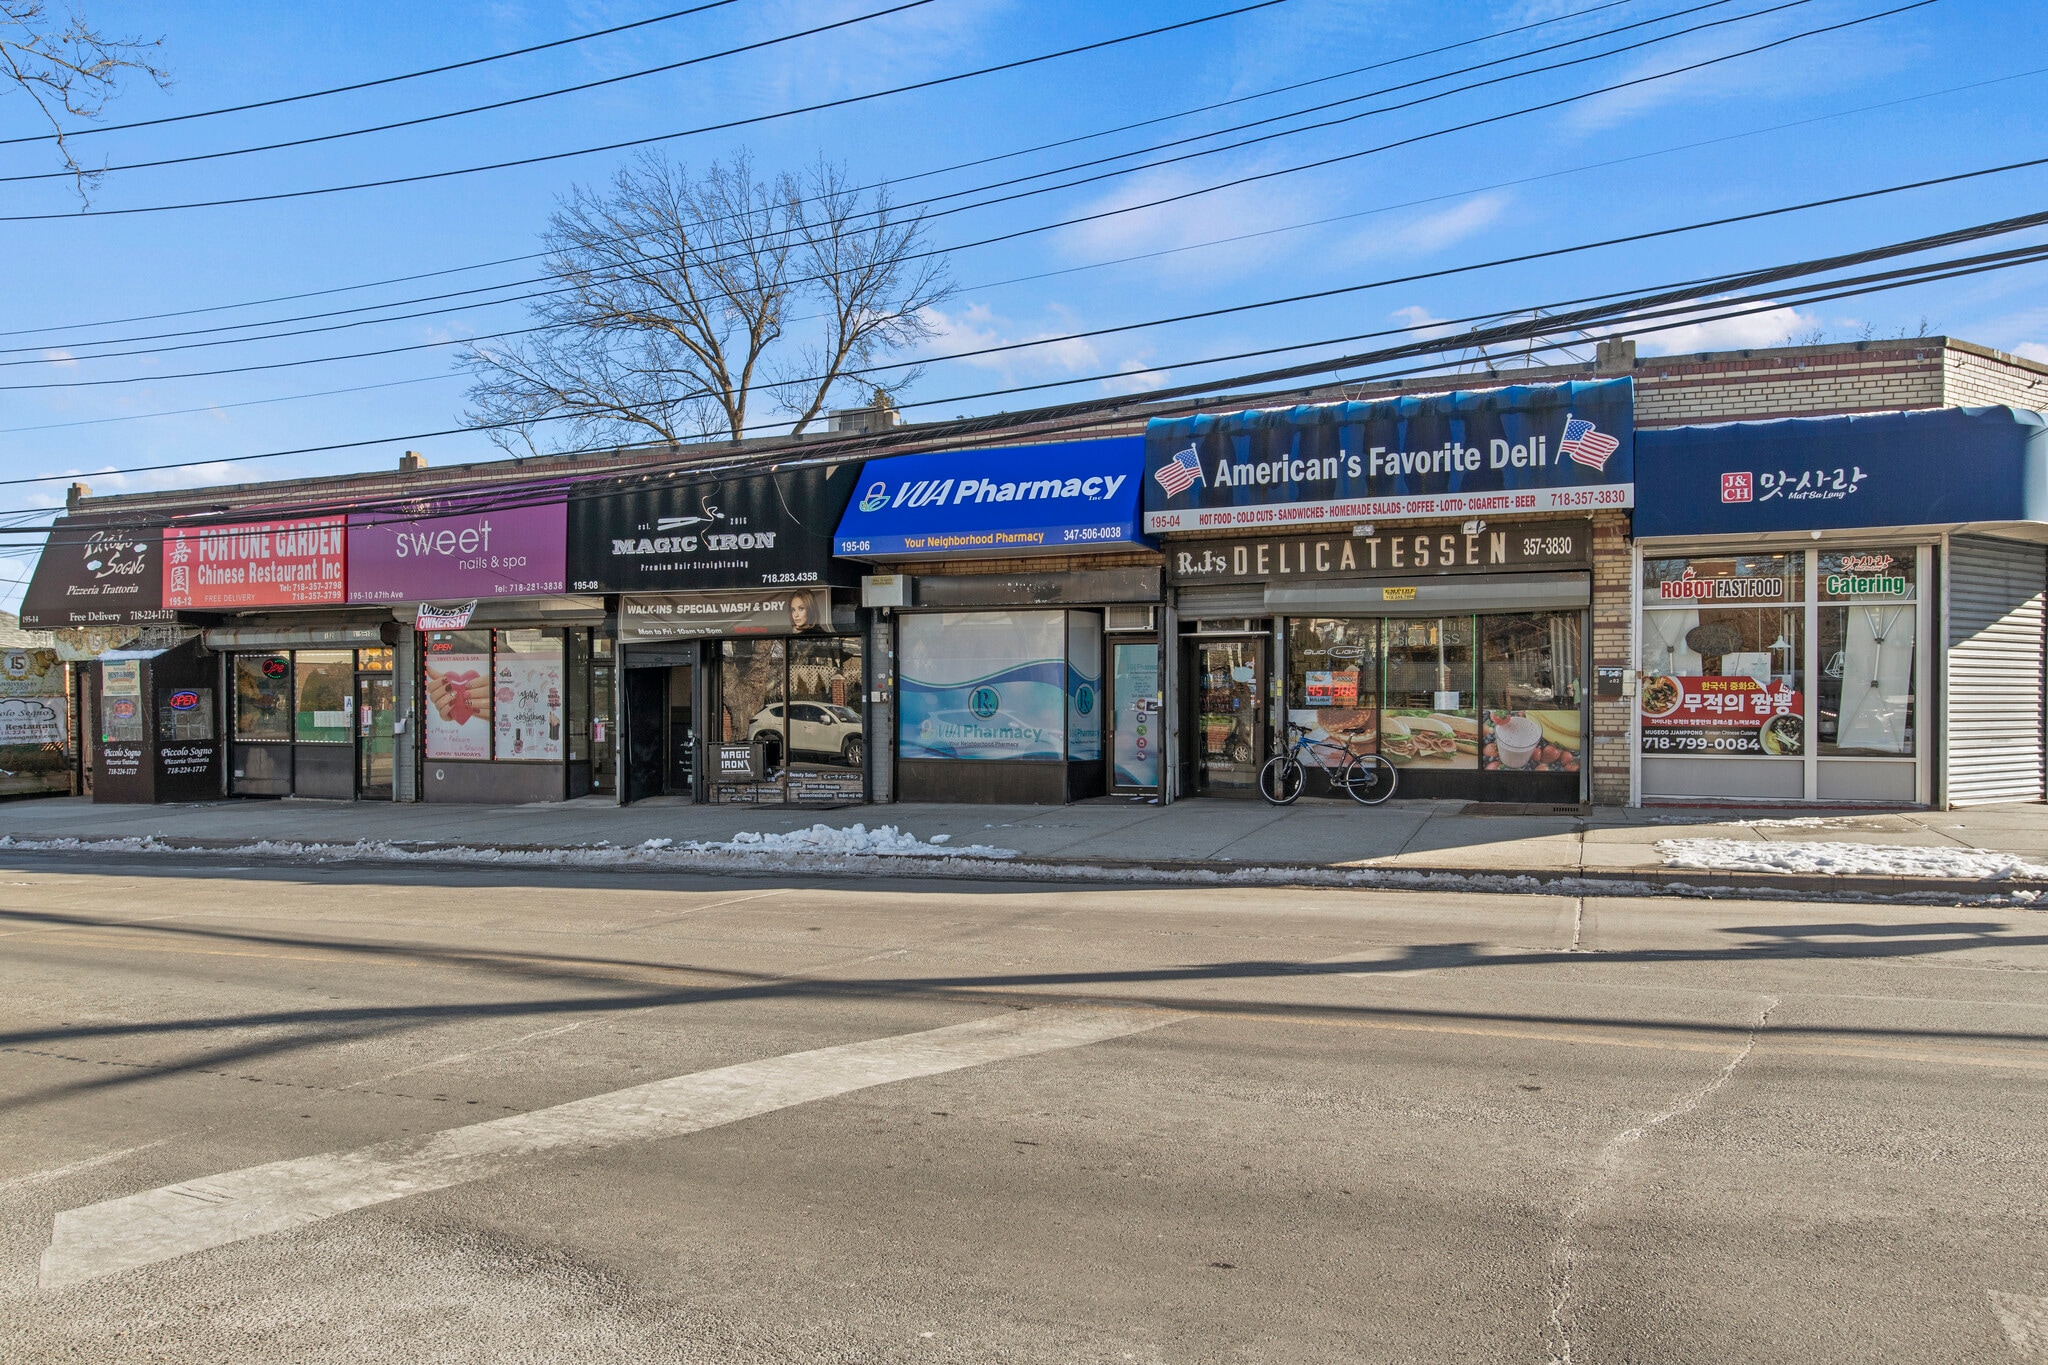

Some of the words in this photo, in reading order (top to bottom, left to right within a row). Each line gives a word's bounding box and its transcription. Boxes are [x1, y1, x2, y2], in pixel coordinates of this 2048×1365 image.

[1214, 448, 1362, 489] American's
[1369, 441, 1481, 478] Favorite
[1489, 435, 1546, 470] Deli
[1725, 474, 1747, 488] J&
[953, 474, 1127, 505] Pharmacy
[1723, 488, 1750, 501] CH
[1551, 489, 1626, 507] 718-357-3830
[1199, 513, 1213, 525] HOT
[1213, 512, 1232, 524] FOOD
[1236, 511, 1255, 523] COLD
[1256, 510, 1274, 522] CUTS
[1278, 506, 1325, 520] SANDWICHES
[1329, 503, 1372, 517] HOMEMADE
[1372, 501, 1401, 515] SALADS
[1406, 499, 1435, 513] COFFEE
[1440, 498, 1463, 511] LOTTO
[1468, 496, 1510, 510] CIGARETTE
[1515, 494, 1536, 508] BEER
[1150, 515, 1181, 528] 195-04
[199, 525, 271, 562] FORTUNE
[275, 519, 342, 559] GARDEN
[396, 520, 492, 558] sweet
[904, 536, 925, 549] Your
[927, 533, 994, 548] Neighborhood
[996, 531, 1045, 545] Pharmacy
[1063, 527, 1121, 541] 347-506-0038
[612, 536, 697, 555] MAGIC
[708, 531, 777, 551] IRON
[841, 541, 870, 553] 195-06
[1234, 532, 1507, 575] DELICATESSEN
[1523, 536, 1573, 556] 357-3830
[459, 557, 488, 571] nails
[491, 556, 500, 568] &
[502, 555, 527, 569] spa
[641, 563, 672, 573] Premium
[674, 562, 691, 571] Hair
[198, 564, 245, 586] Chinese
[249, 561, 320, 583] Restaurant
[322, 558, 341, 580] Inc
[762, 572, 818, 584] 718.283.4358
[66, 585, 100, 596] Pizzeria
[101, 583, 139, 595] Trattoria
[279, 583, 292, 592] Tel:
[292, 582, 342, 591] 718-357-3798
[494, 584, 508, 593] Tel:
[509, 582, 563, 592] 718-281-3838
[573, 580, 599, 590] 195-08
[1661, 580, 1714, 599] ROBOT
[1827, 574, 1905, 595] Catering
[168, 597, 192, 606] 195-12
[204, 595, 222, 603] FREE
[224, 594, 256, 602] DELIVERY
[292, 591, 342, 601] 718-357-3799
[350, 592, 373, 600] 195-10
[374, 591, 389, 599] 47th
[390, 590, 404, 599] Ave
[422, 604, 457, 616] UNDER
[627, 604, 673, 615] WALK-INS
[676, 603, 719, 615] SPECIAL
[720, 602, 752, 613] WASH
[753, 602, 760, 612] &
[763, 600, 786, 612] DRY
[22, 615, 39, 623] 195-14
[69, 612, 87, 622] Free
[88, 611, 121, 622] Delivery
[130, 610, 174, 620] 718-224-1717
[637, 627, 653, 635] Mon
[662, 627, 672, 635] Fri
[432, 643, 453, 652] OPEN
[10, 656, 26, 670] 15
[170, 693, 198, 708] OPEN
[346, 698, 353, 707] A
[1684, 693, 1745, 714] 무적의
[1750, 692, 1793, 716] 짬뽕
[6, 723, 58, 731] Restaurant
[963, 724, 1043, 743] Pharmacy
[1643, 737, 1760, 750] 718-799-0084
[104, 748, 124, 757] Piccolo
[124, 748, 141, 759] Sogno
[161, 747, 189, 757] Piccolo
[189, 747, 212, 757] Sogno
[721, 751, 751, 759] MAGIC
[167, 766, 208, 775] 718-224-1717
